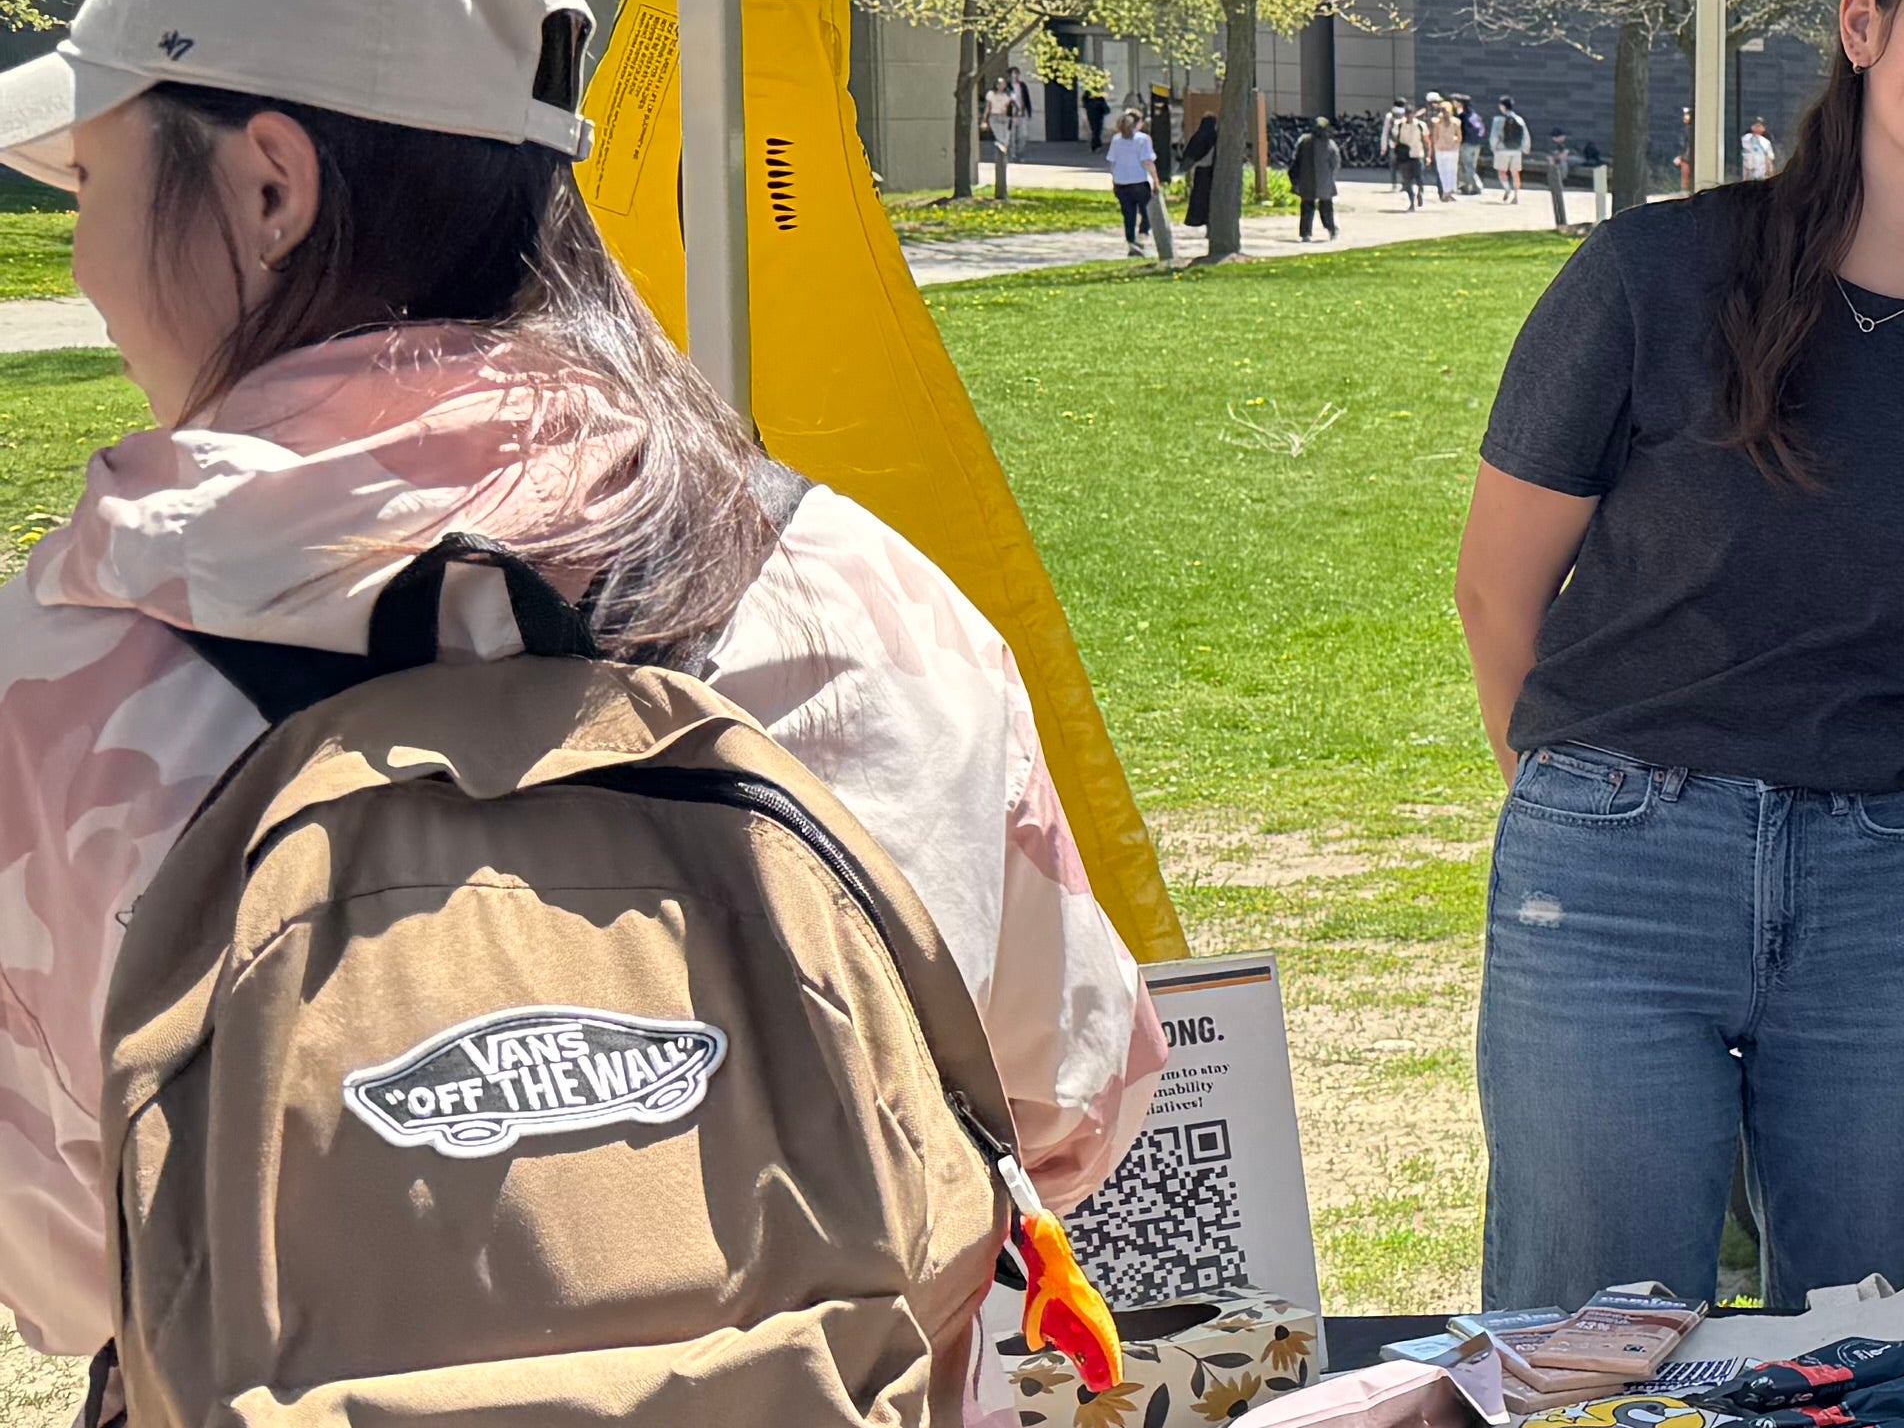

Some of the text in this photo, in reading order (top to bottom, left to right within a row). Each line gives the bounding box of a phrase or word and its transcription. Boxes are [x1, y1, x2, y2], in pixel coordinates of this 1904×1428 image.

[385, 1037, 694, 1117] "OFF THE WALL"
[461, 1022, 591, 1077] VANS
[1181, 1068, 1198, 1078] to
